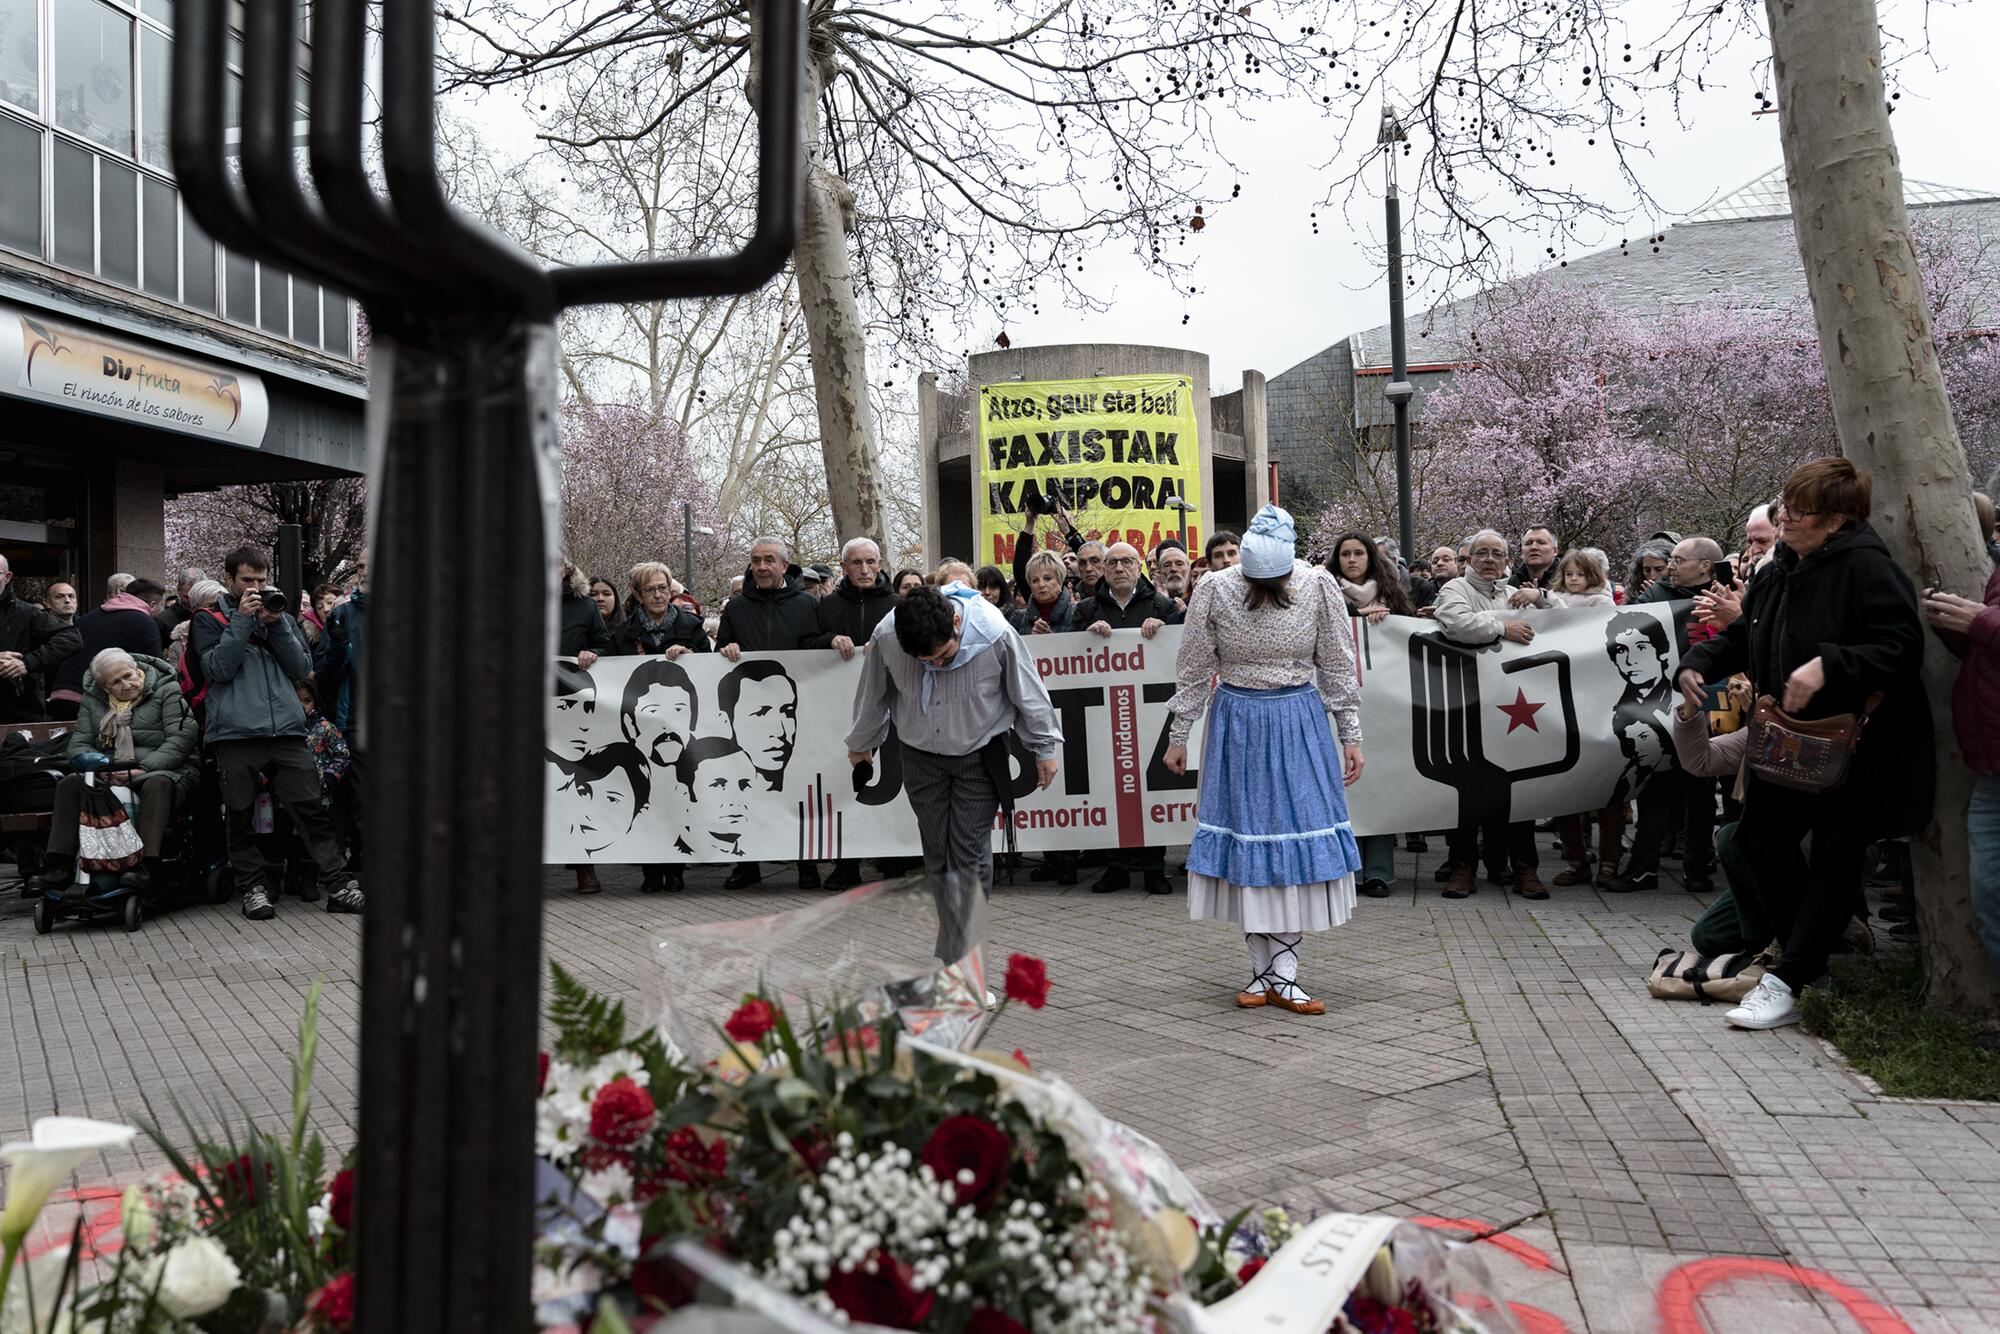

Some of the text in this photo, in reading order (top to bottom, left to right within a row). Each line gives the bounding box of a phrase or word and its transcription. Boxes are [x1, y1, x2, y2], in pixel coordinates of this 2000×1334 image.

[63, 383, 203, 426] El rincón de los sabores
[988, 396, 1042, 421] Atzo,
[1046, 393, 1097, 421] gaur
[1103, 390, 1136, 414] eta
[988, 429, 1179, 471] FAXISTAK
[1033, 644, 1145, 682] punidad
[1116, 689, 1135, 793] no olvidamos
